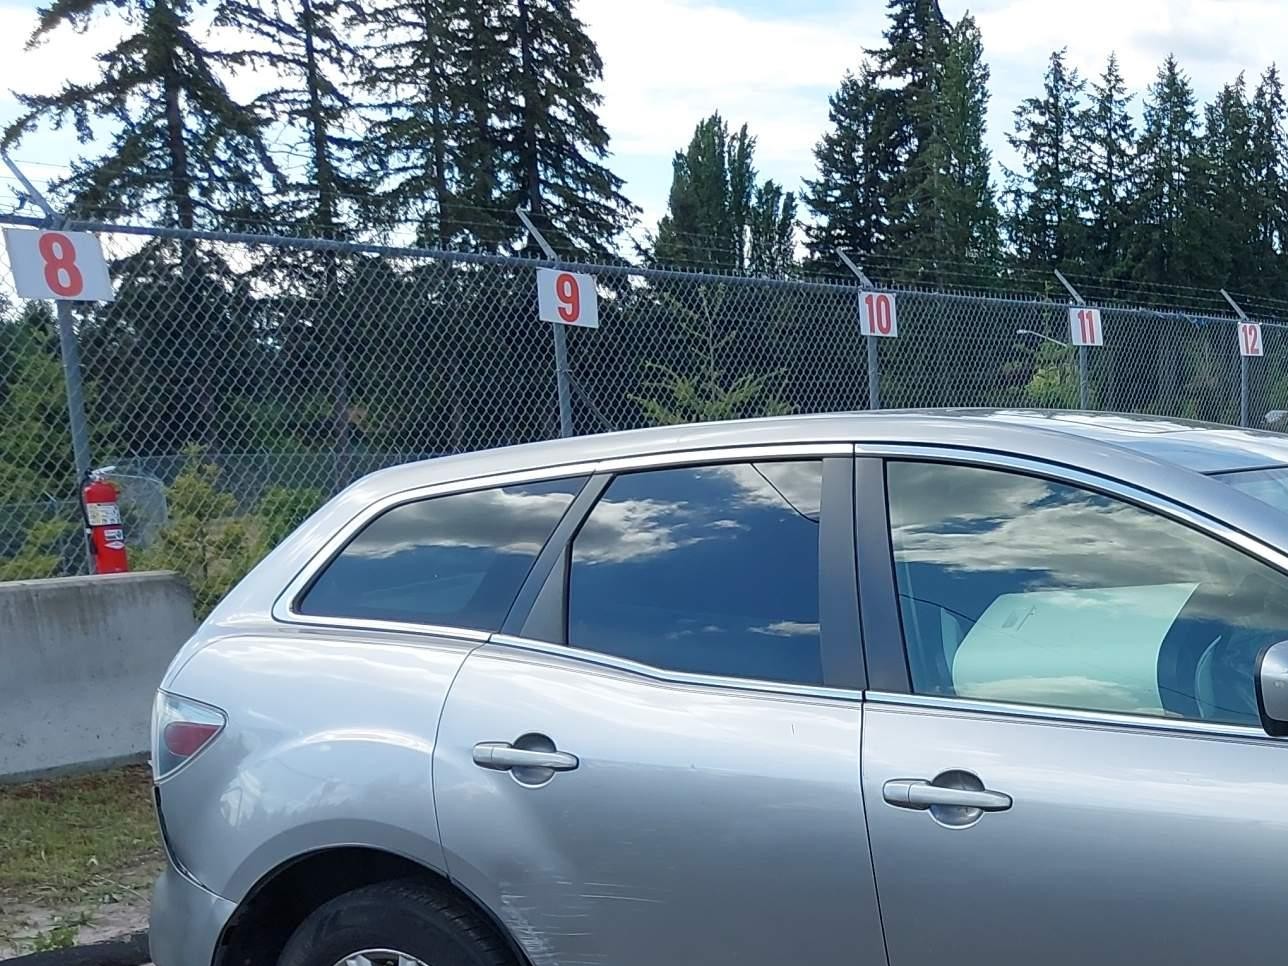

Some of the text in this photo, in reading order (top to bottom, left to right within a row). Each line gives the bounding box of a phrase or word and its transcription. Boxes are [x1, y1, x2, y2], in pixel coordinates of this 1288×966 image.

[39, 233, 83, 297] 8
[556, 273, 580, 323] 9
[865, 295, 892, 335] 10
[1078, 311, 1096, 343] 11
[1243, 325, 1259, 354] 12
